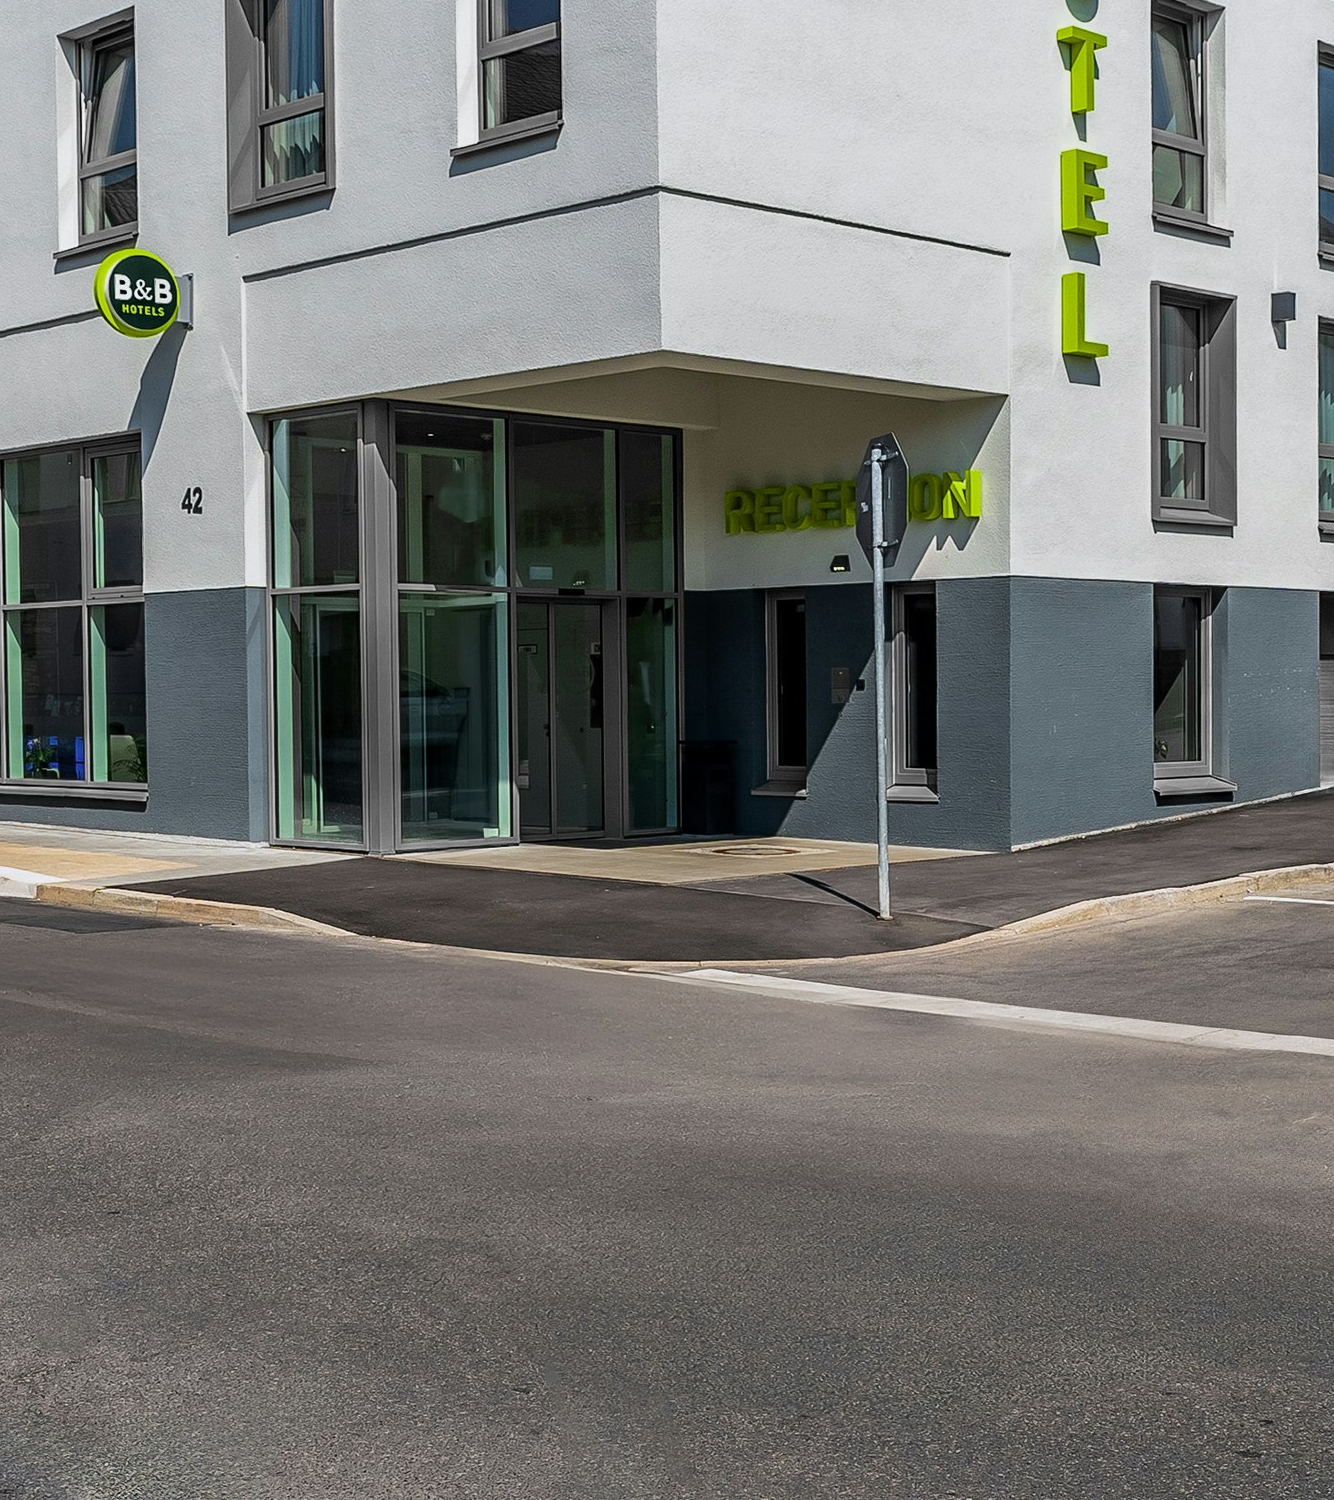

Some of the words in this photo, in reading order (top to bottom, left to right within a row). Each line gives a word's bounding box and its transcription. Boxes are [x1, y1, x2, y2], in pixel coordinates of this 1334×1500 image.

[114, 273, 173, 305] B&B
[121, 303, 165, 317] HOTELS
[181, 486, 203, 514] 42
[724, 469, 983, 534] RECEON
